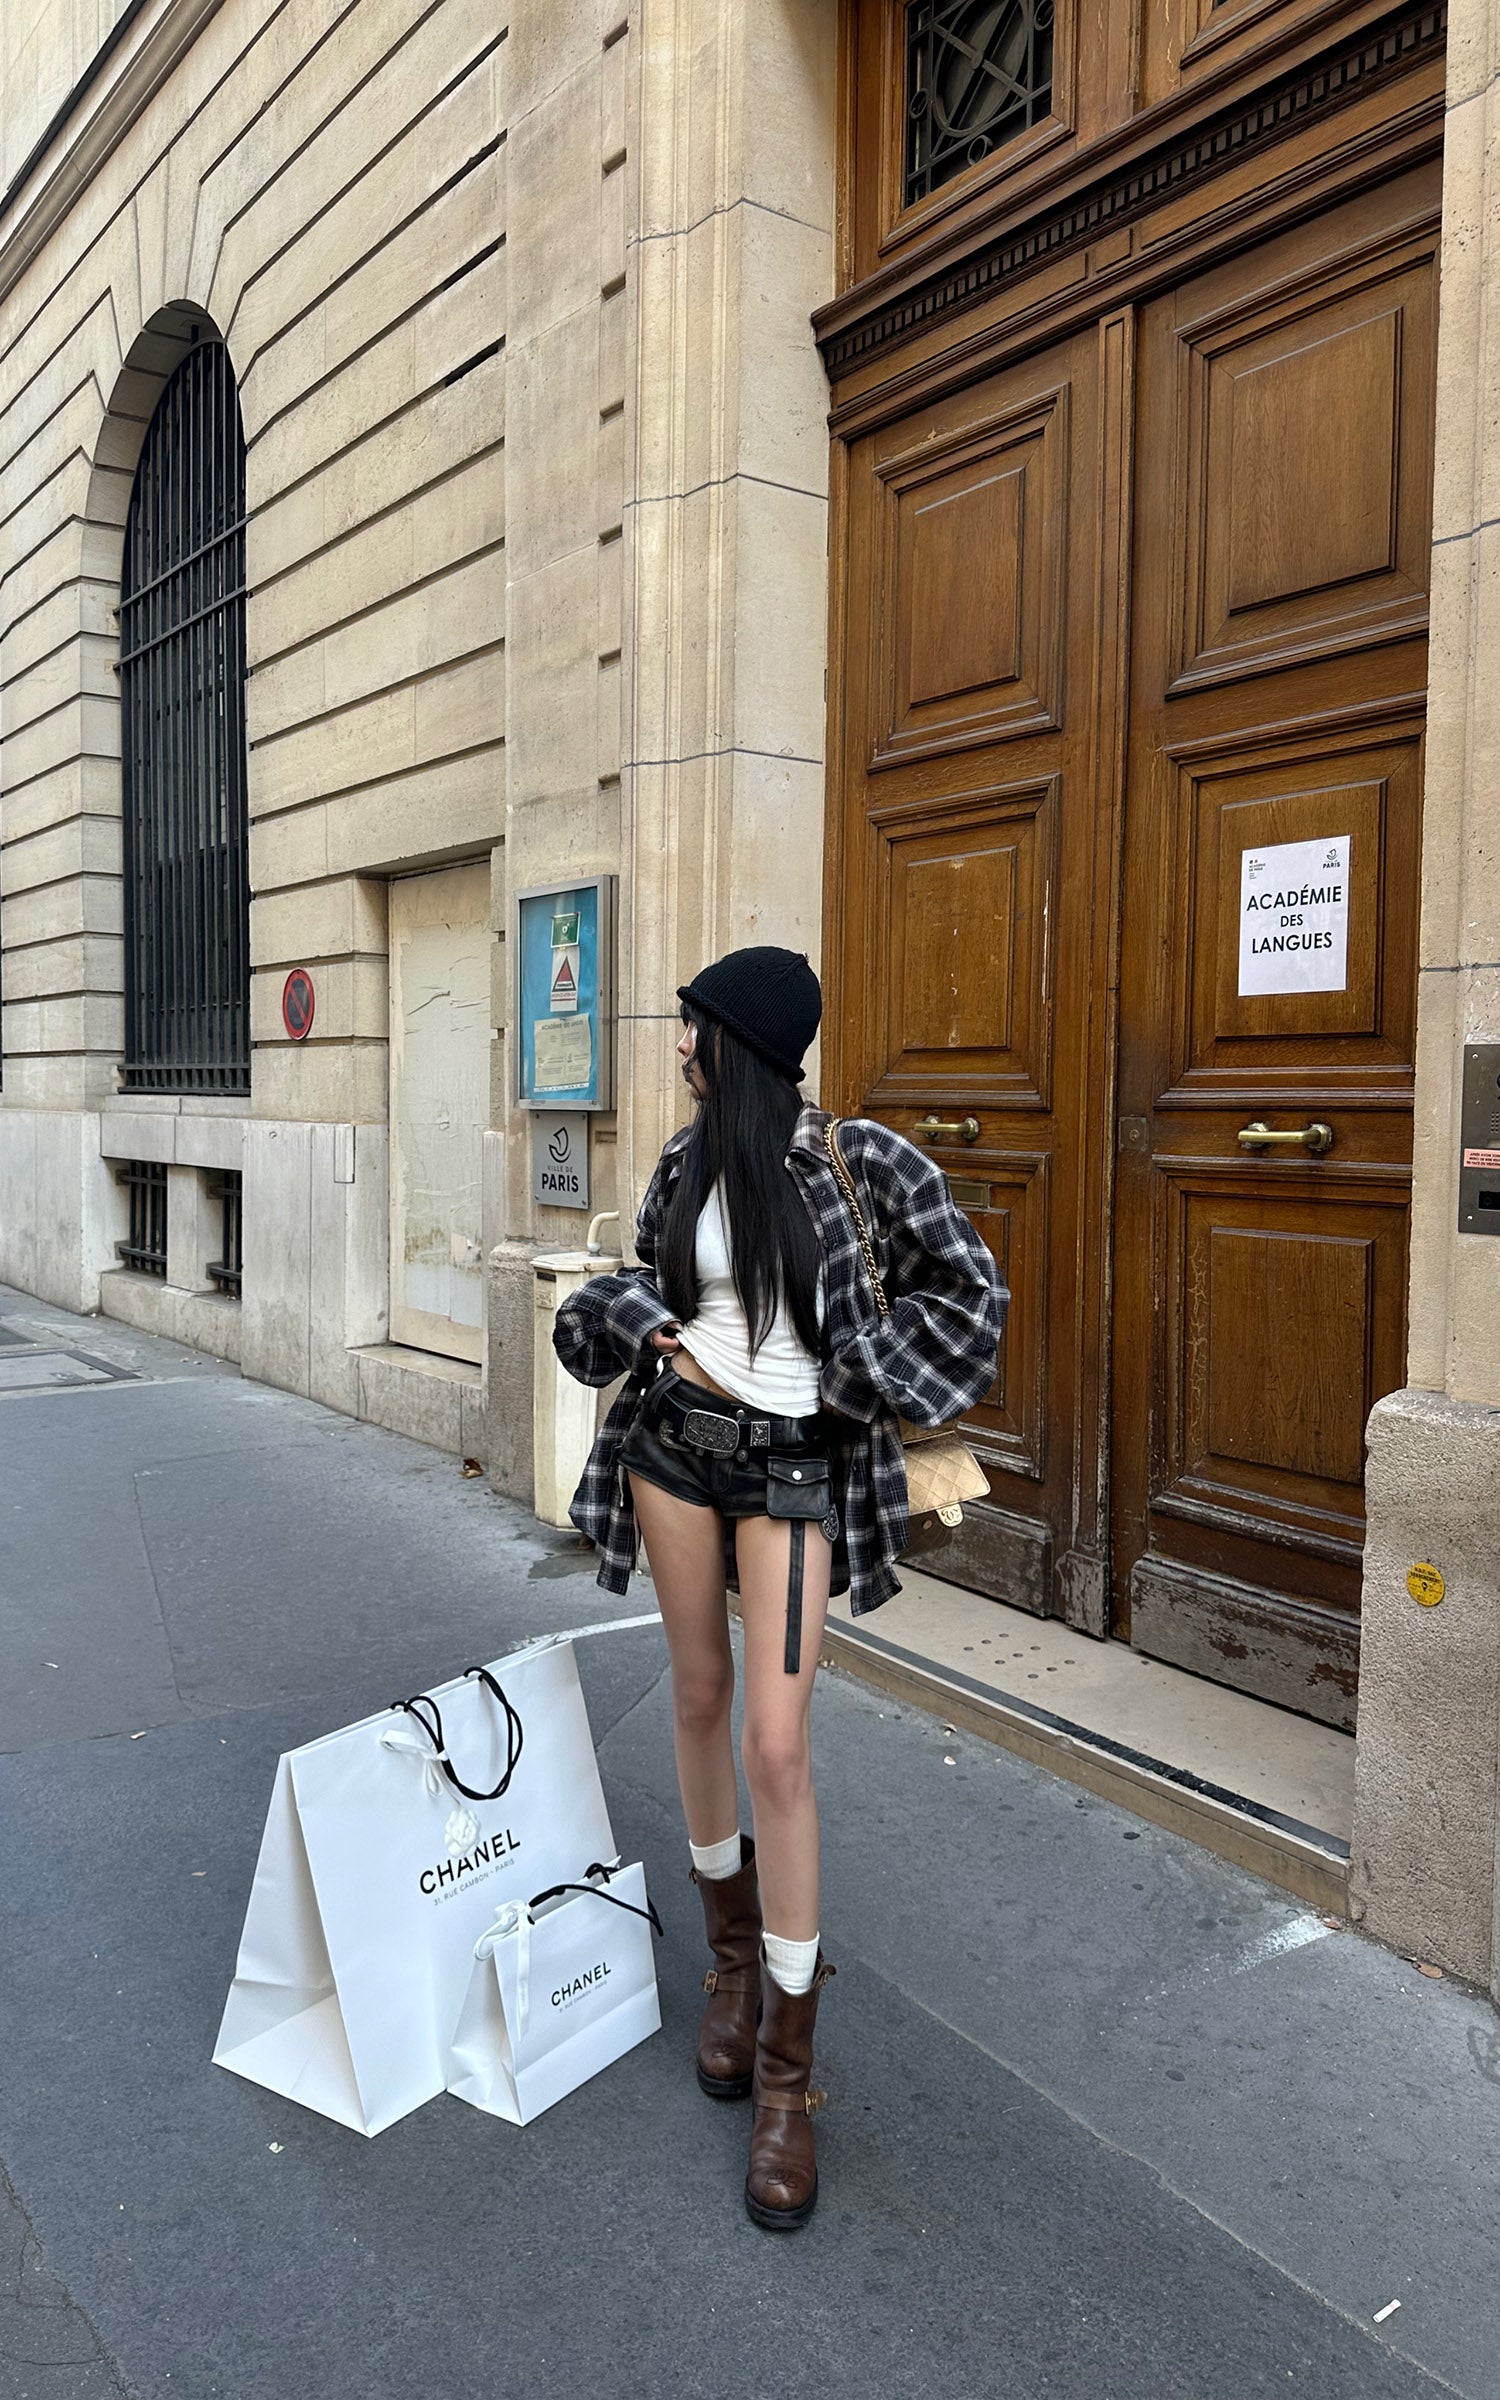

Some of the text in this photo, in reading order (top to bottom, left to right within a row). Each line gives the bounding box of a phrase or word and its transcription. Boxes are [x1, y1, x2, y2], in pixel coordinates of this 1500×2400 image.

[1246, 884, 1342, 911] ACADÉMIE
[1280, 914, 1303, 927] DES
[1252, 932, 1332, 954] LANGUES
[542, 1173, 579, 1193] PARIS
[419, 1829, 521, 1894] CHANEL
[444, 1887, 458, 1900] RUE
[459, 1871, 489, 1892] CAMBON
[495, 1858, 515, 1872] PARIS
[551, 1961, 612, 2007] CHANEL
